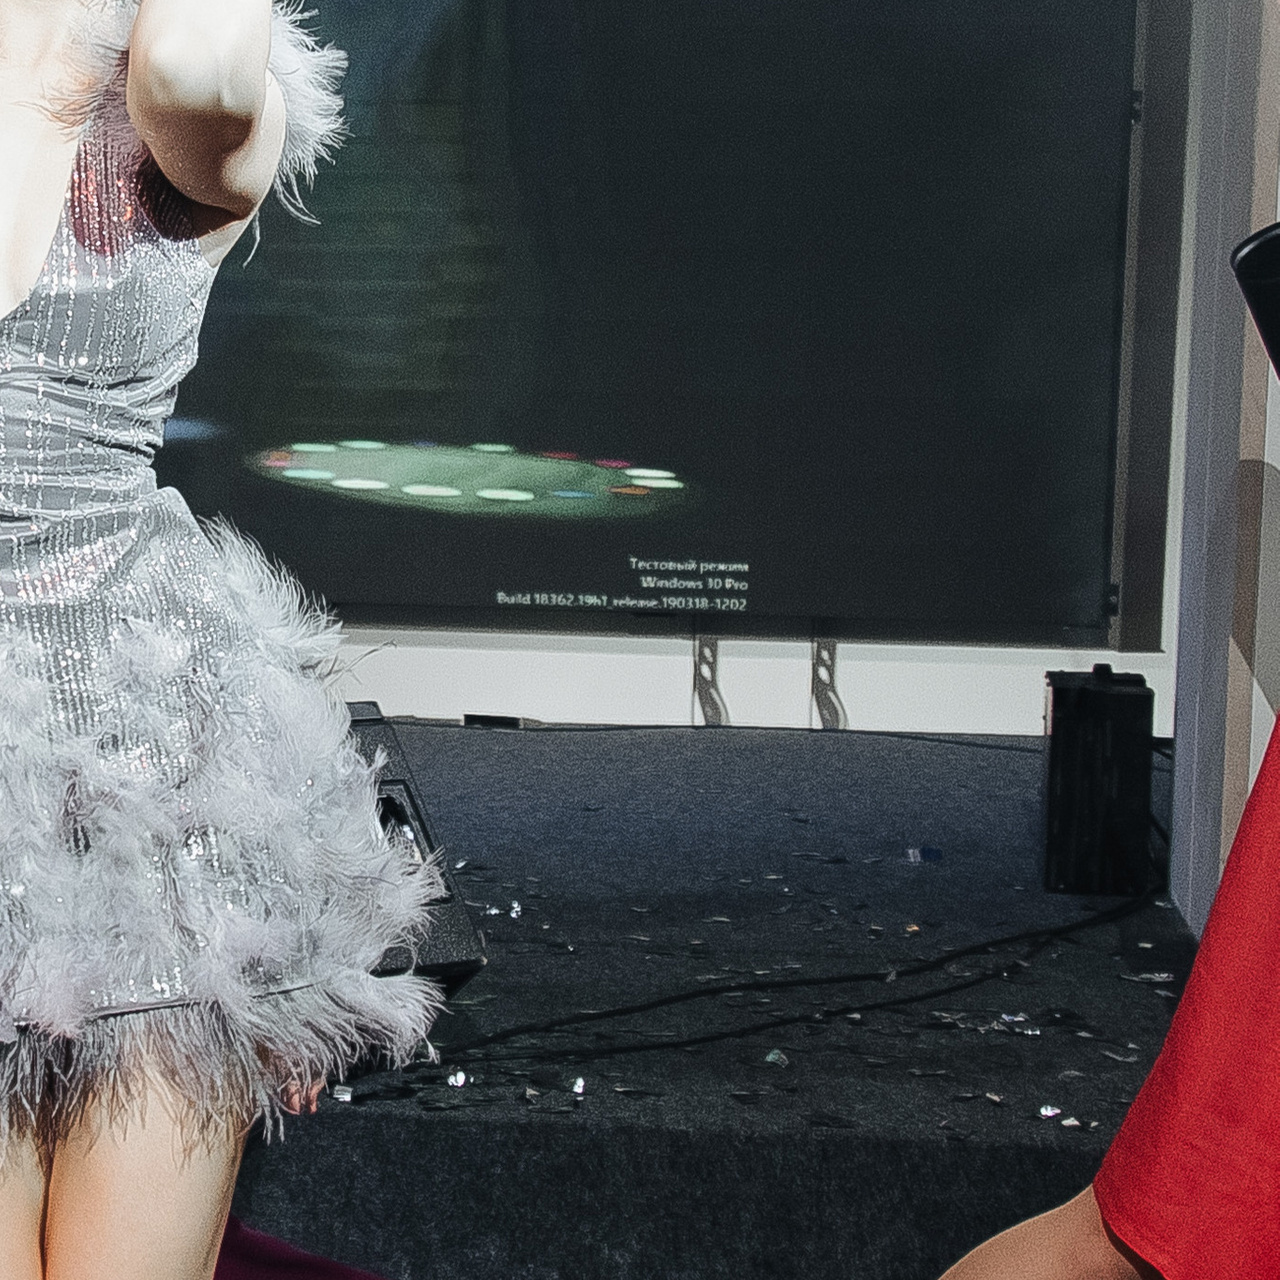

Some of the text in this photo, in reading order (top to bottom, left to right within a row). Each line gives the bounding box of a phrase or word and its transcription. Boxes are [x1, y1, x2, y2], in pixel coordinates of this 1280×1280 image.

[629, 557, 697, 572] Тестовый
[640, 577, 749, 591] Windows 10 Pro
[496, 591, 531, 605] Build
